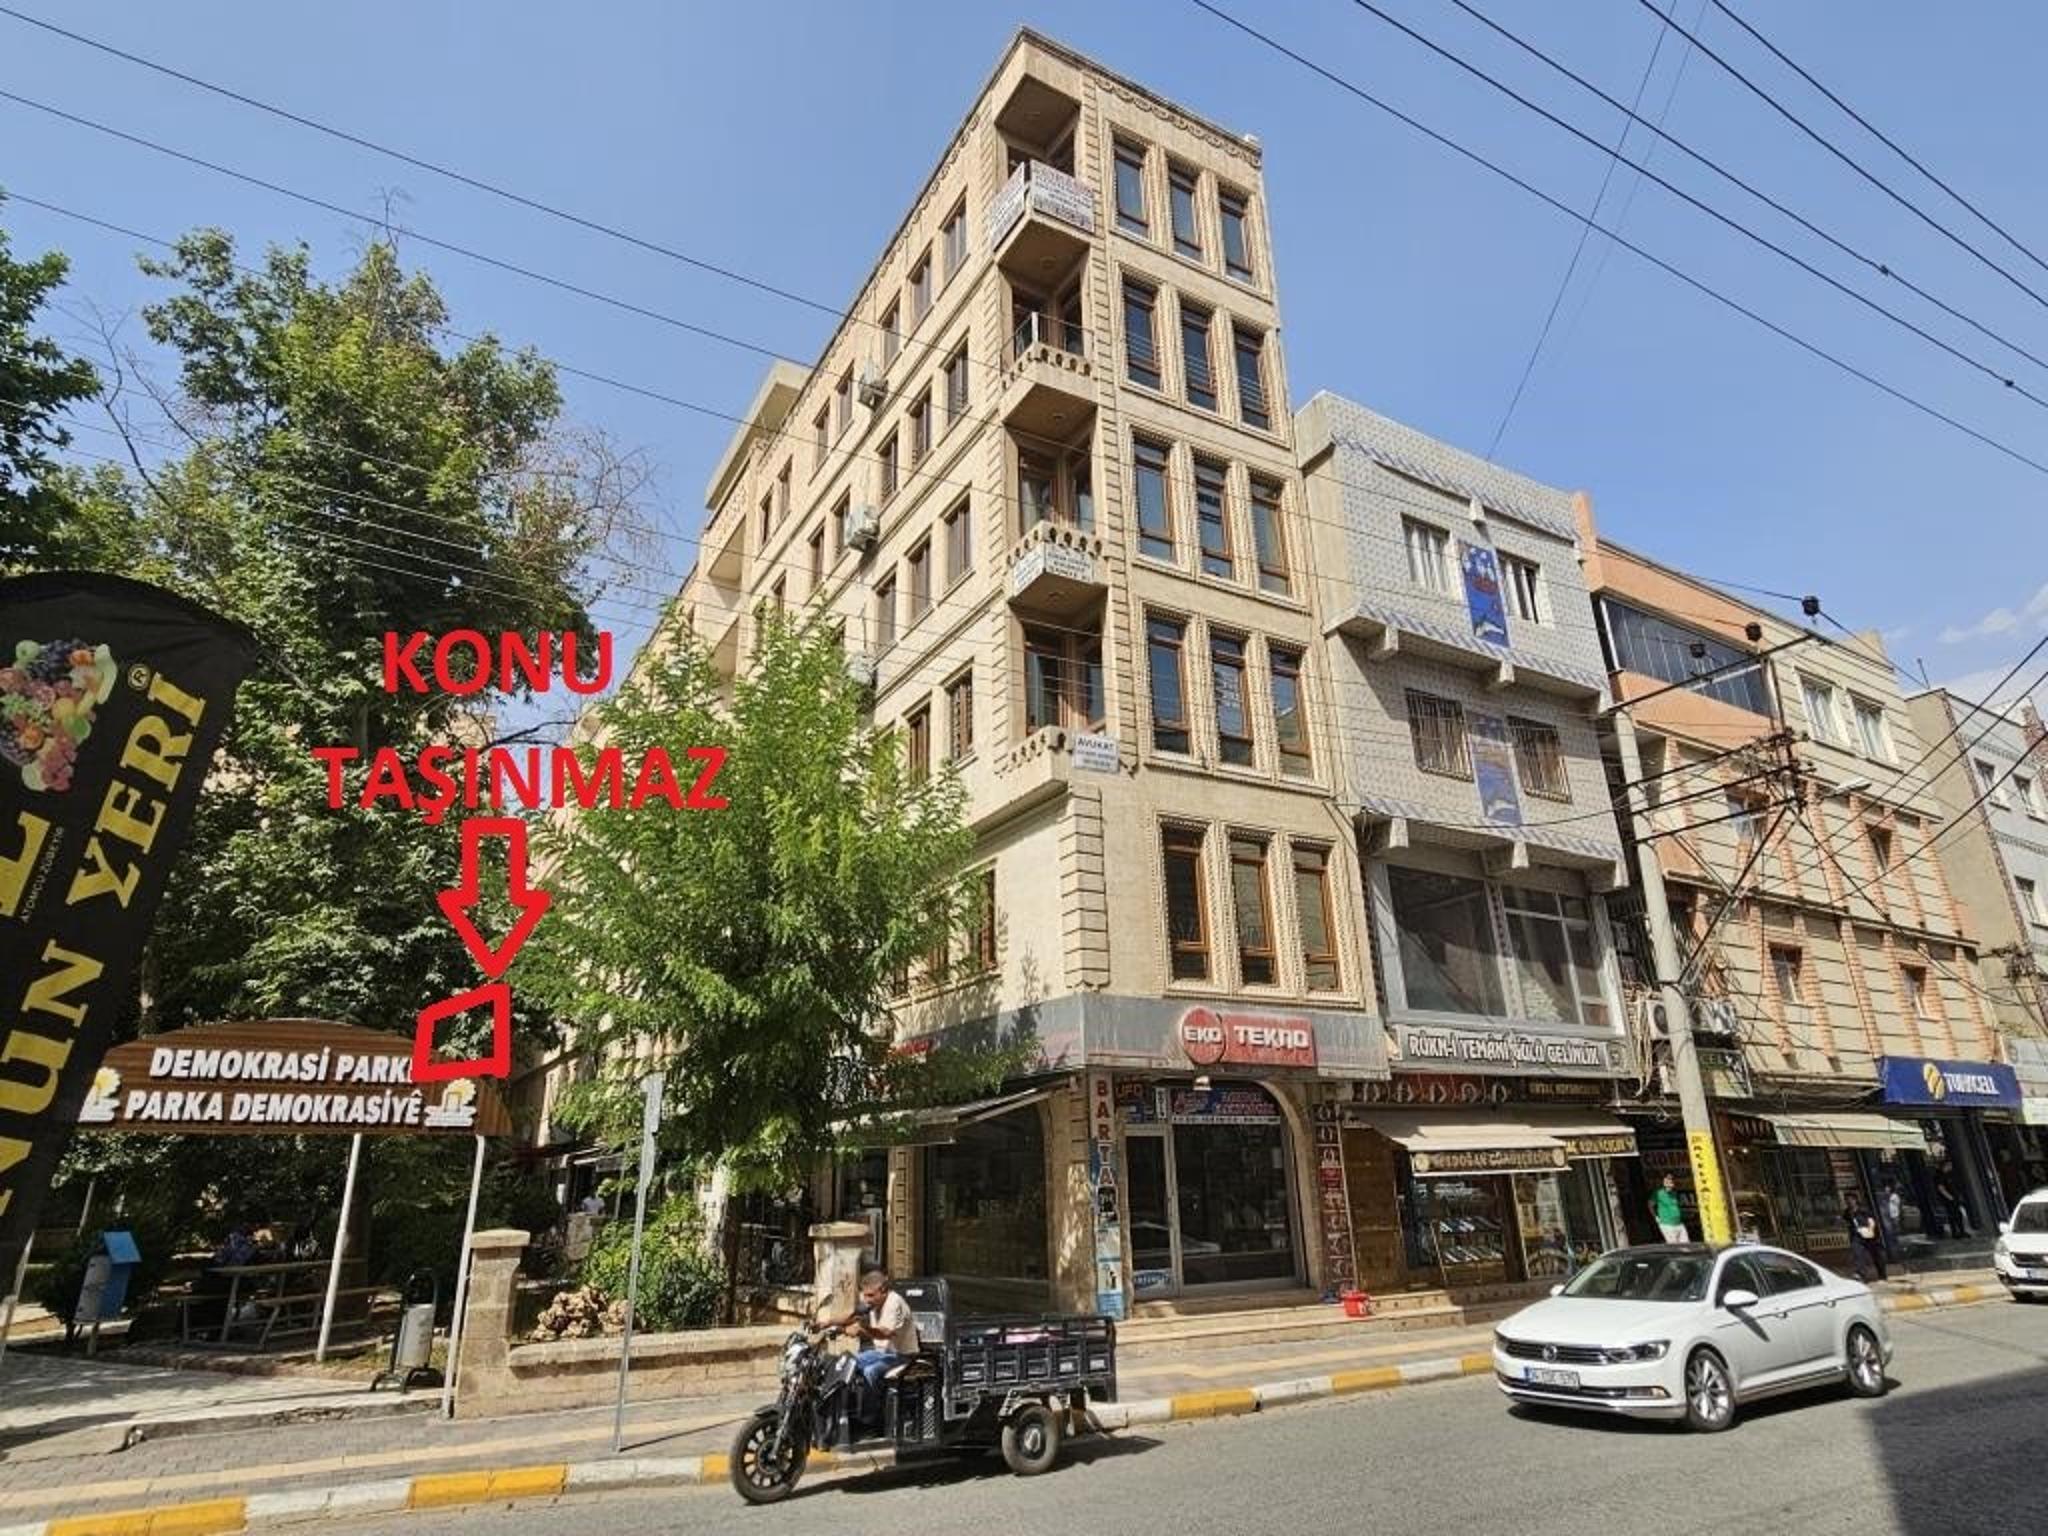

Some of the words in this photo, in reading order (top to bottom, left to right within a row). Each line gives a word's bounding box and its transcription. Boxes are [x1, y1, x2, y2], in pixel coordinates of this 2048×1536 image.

[1183, 1025, 1222, 1043] EKO
[1233, 1024, 1310, 1050] TEKNO
[150, 1047, 329, 1081] DEMOKRASİ
[124, 1090, 222, 1122] PARKA
